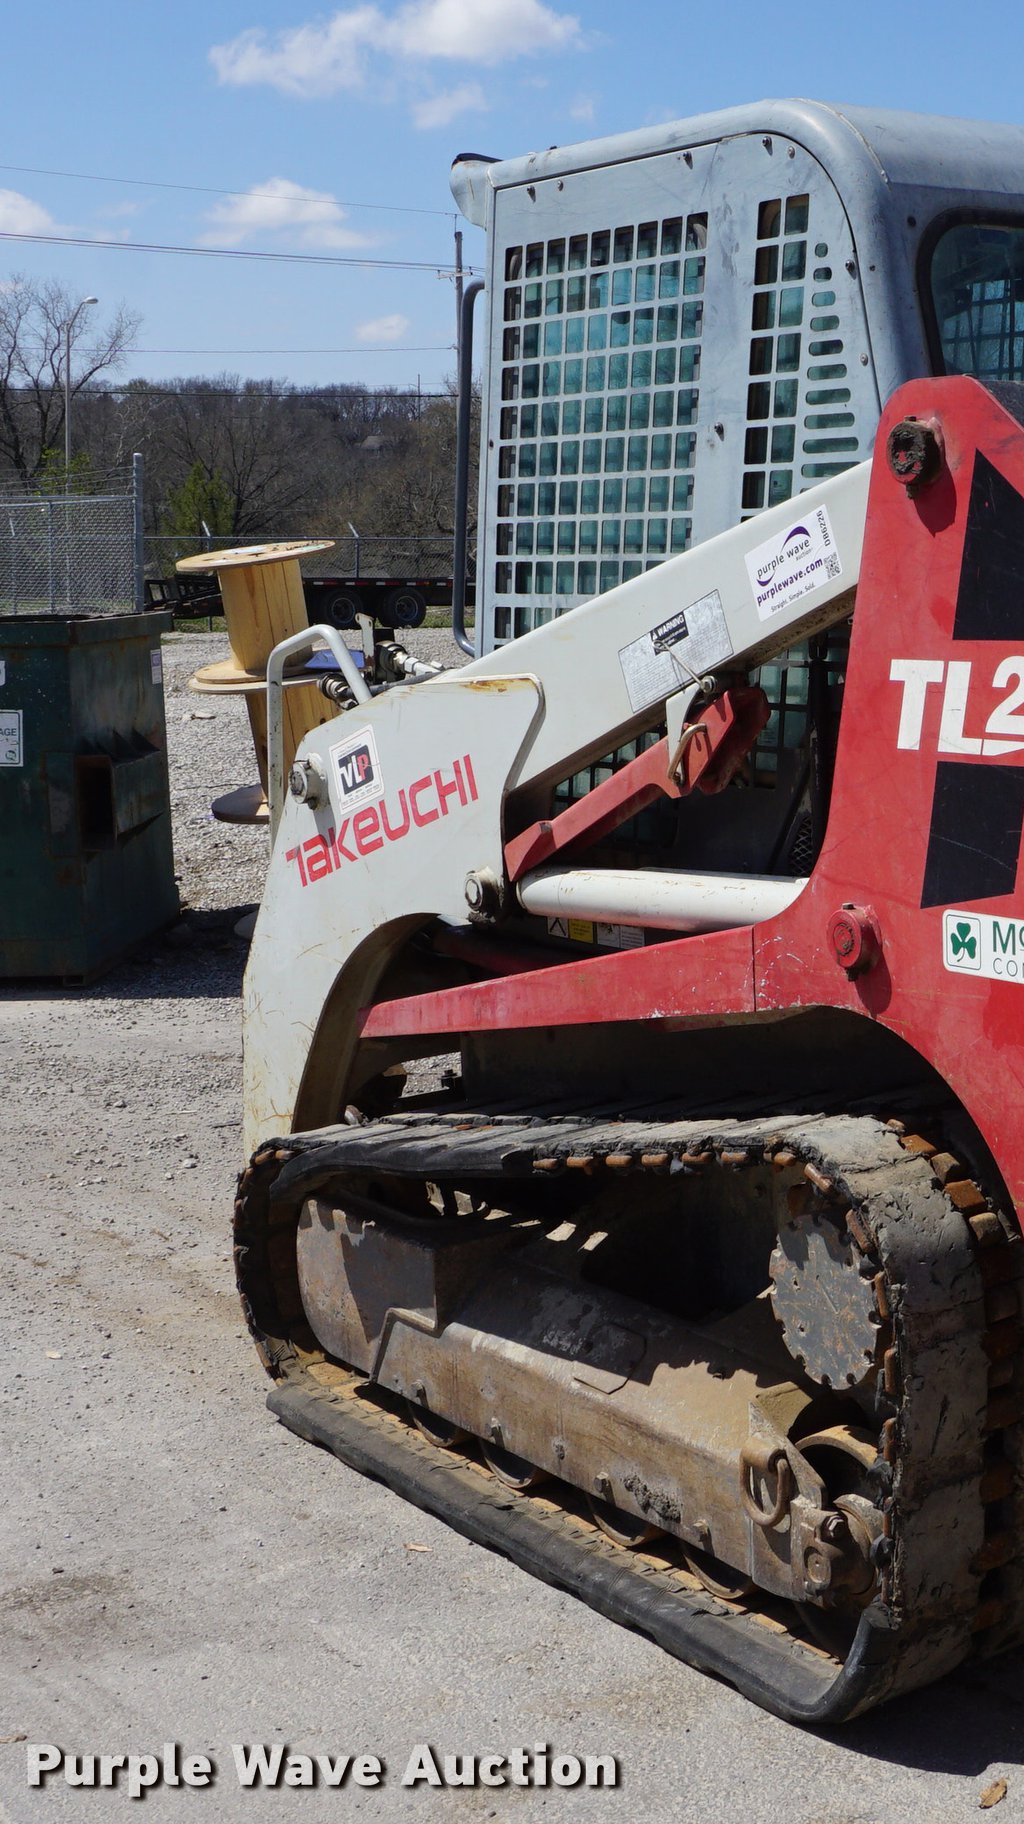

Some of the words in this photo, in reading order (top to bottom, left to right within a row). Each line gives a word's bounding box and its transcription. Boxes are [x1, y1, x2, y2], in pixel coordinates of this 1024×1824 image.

[757, 554, 784, 579] purple
[786, 539, 810, 559] wave
[757, 558, 824, 607] purplewave.com
